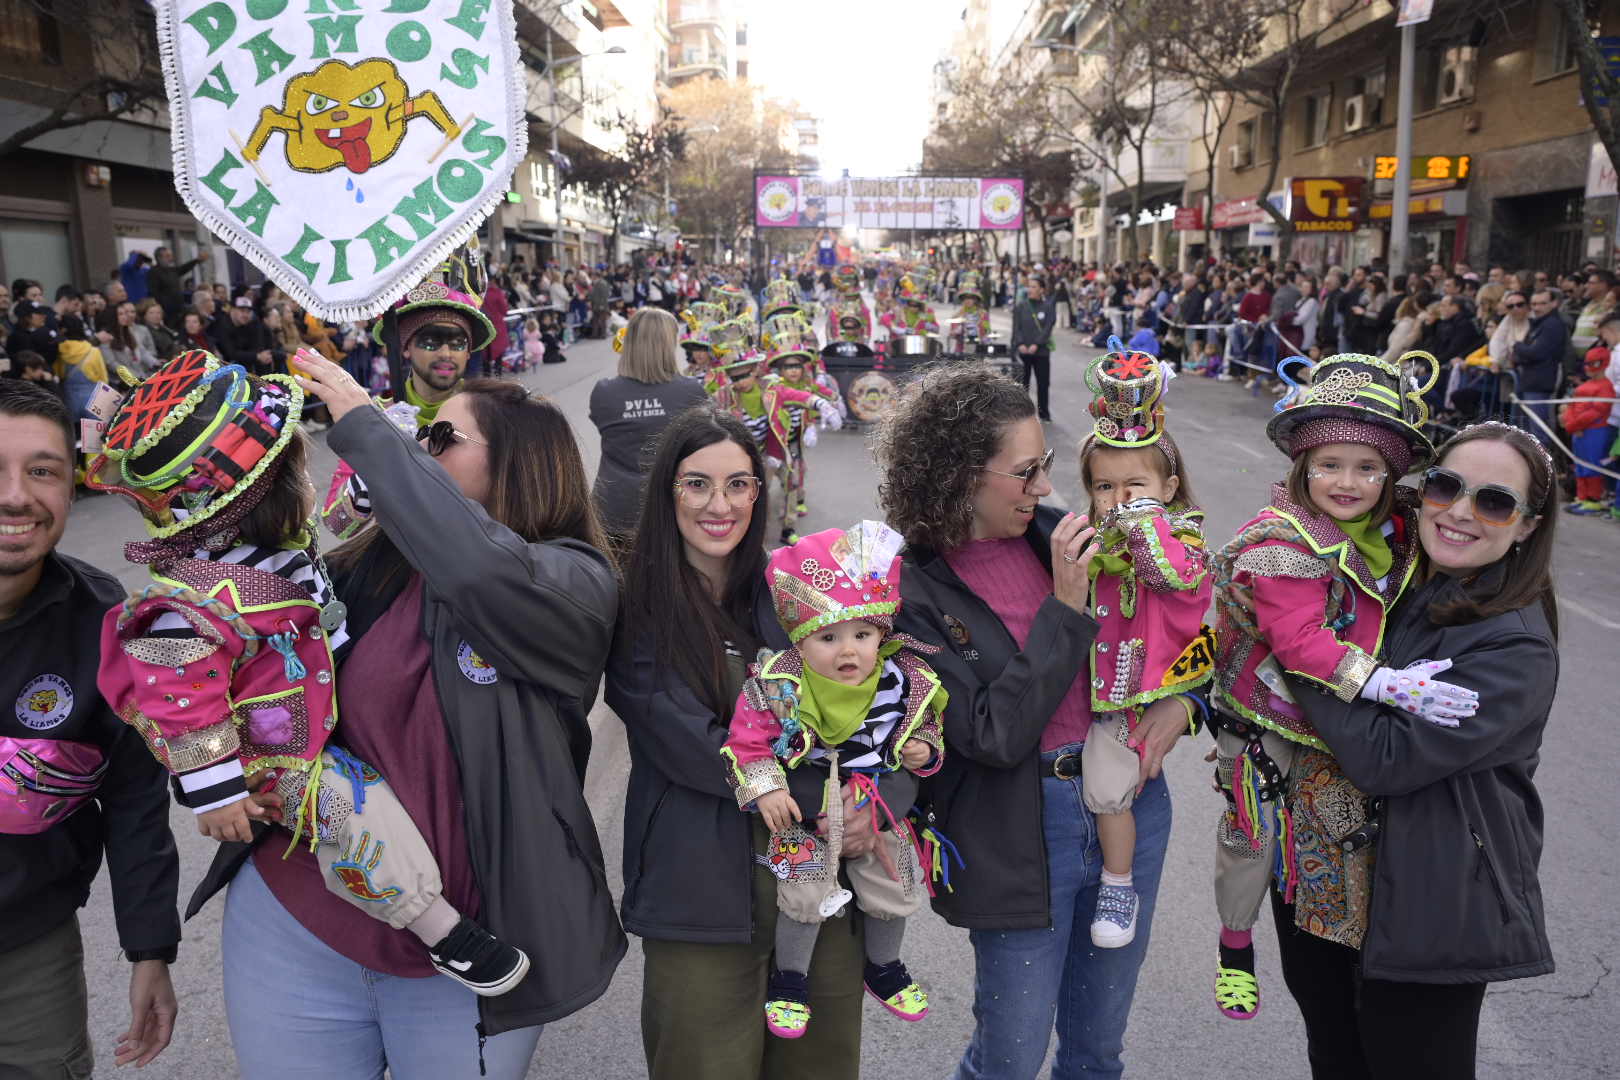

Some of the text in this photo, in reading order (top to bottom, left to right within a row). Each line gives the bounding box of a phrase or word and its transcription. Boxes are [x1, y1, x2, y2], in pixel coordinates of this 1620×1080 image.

[192, 15, 490, 110] VAMOS
[200, 117, 518, 286] LA LIAMOS
[91, 404, 102, 416] 20
[625, 398, 662, 410] DVLL
[18, 712, 66, 728] LA LIAMOS
